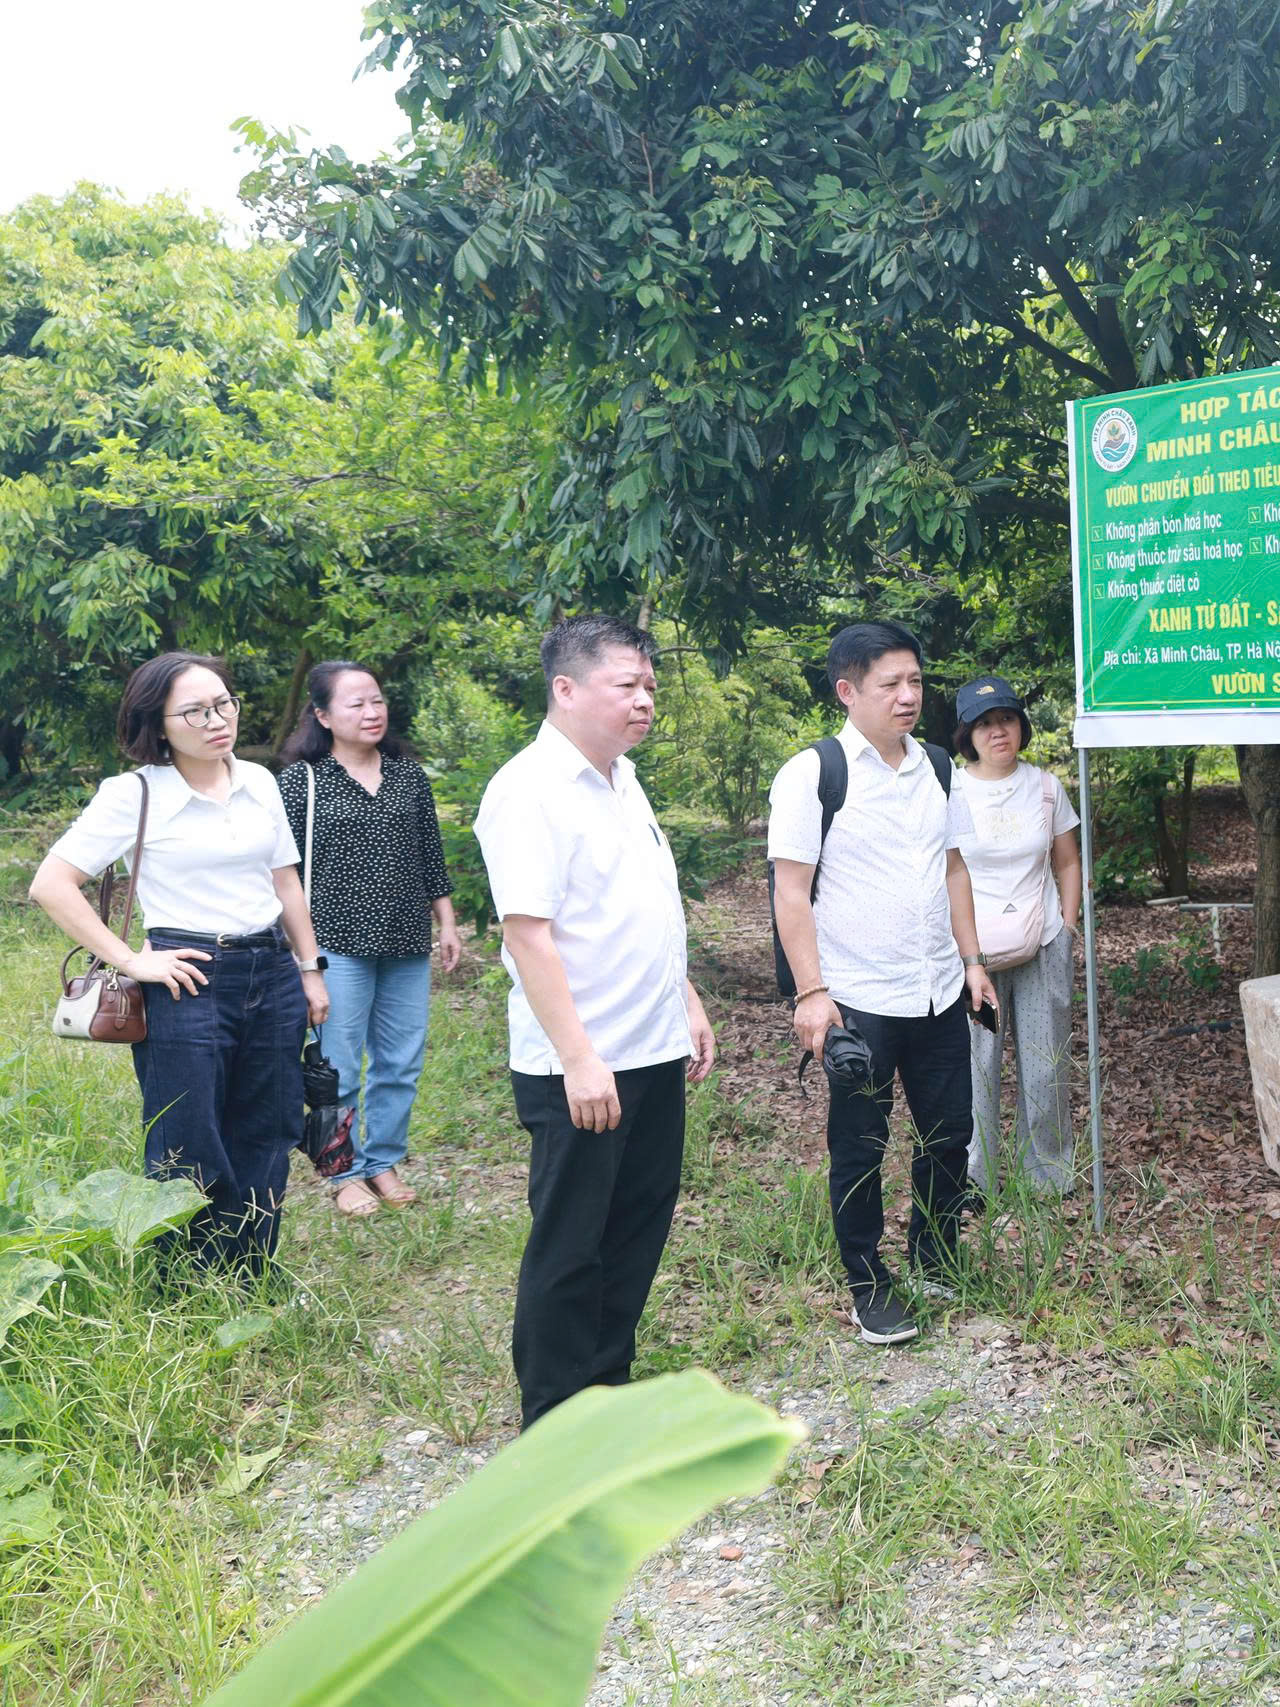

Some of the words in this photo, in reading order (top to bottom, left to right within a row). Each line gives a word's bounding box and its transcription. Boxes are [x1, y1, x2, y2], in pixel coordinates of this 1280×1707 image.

[1181, 396, 1230, 425] HỢP
[1146, 432, 1211, 463] MINH
[1106, 481, 1138, 508] VƯỜN
[1141, 470, 1190, 503] CHUYỂN
[1193, 465, 1215, 496] ĐỔI
[1218, 469, 1250, 493] THEO
[1105, 522, 1136, 543] Không
[1137, 518, 1160, 542] phân
[1162, 514, 1182, 534] bón
[1184, 511, 1201, 529] hoá
[1203, 510, 1222, 533] học
[1107, 551, 1136, 572] Không
[1137, 542, 1166, 566] thuốc
[1167, 544, 1181, 564] trừ
[1183, 543, 1201, 561] sâu
[1203, 540, 1222, 560] hoá
[1224, 539, 1243, 562] học
[1107, 580, 1139, 601] Không
[1140, 572, 1165, 594] thuốc
[1167, 575, 1186, 597] diệt
[1187, 572, 1199, 591] cỏ
[1148, 606, 1192, 633] XANH
[1195, 598, 1217, 630] TỪ
[1103, 650, 1119, 670] Địa
[1121, 645, 1142, 665] chỉ:
[1144, 647, 1158, 664] Xã
[1161, 646, 1187, 663] Minh
[1190, 645, 1224, 663] Châu,
[1226, 643, 1243, 660] TP.
[1247, 642, 1262, 659] Hà
[1211, 668, 1265, 695] VƯỜN
